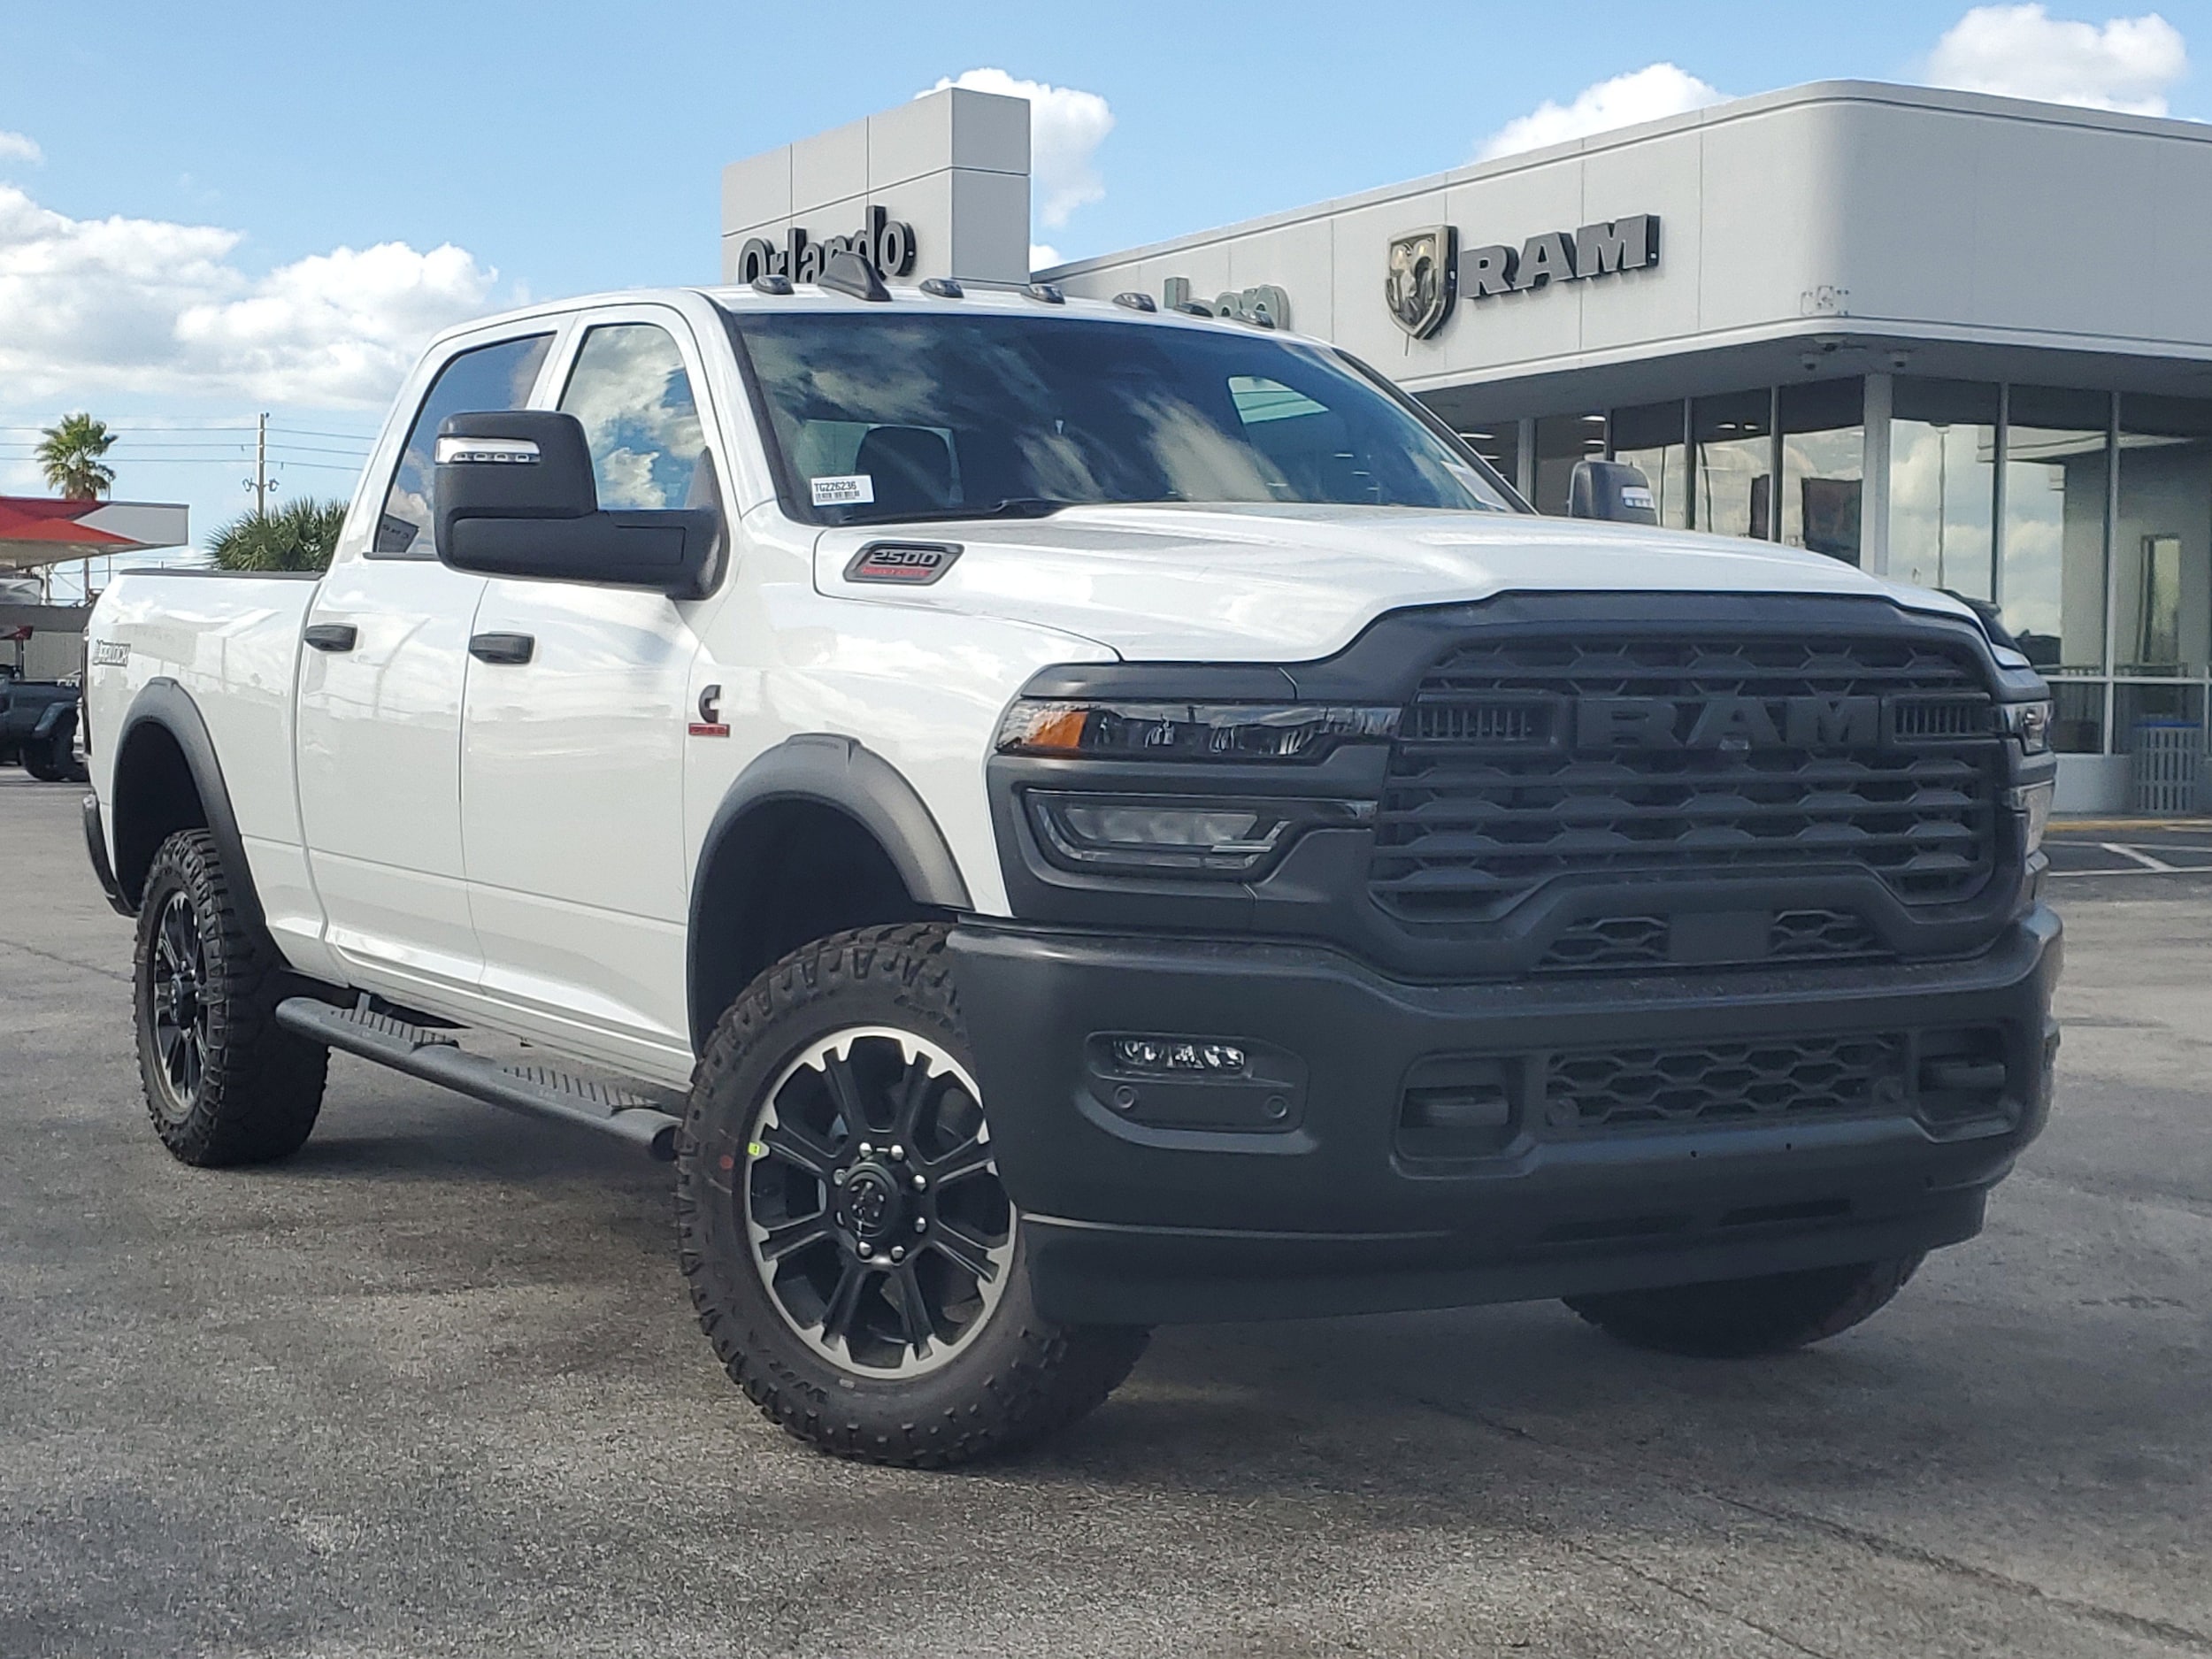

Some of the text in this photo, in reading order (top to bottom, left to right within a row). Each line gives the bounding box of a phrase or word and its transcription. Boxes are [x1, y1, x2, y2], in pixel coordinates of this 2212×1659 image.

[1460, 213, 1661, 300] RAM
[868, 550, 941, 567] 2500
[1578, 696, 1878, 749] RAM
